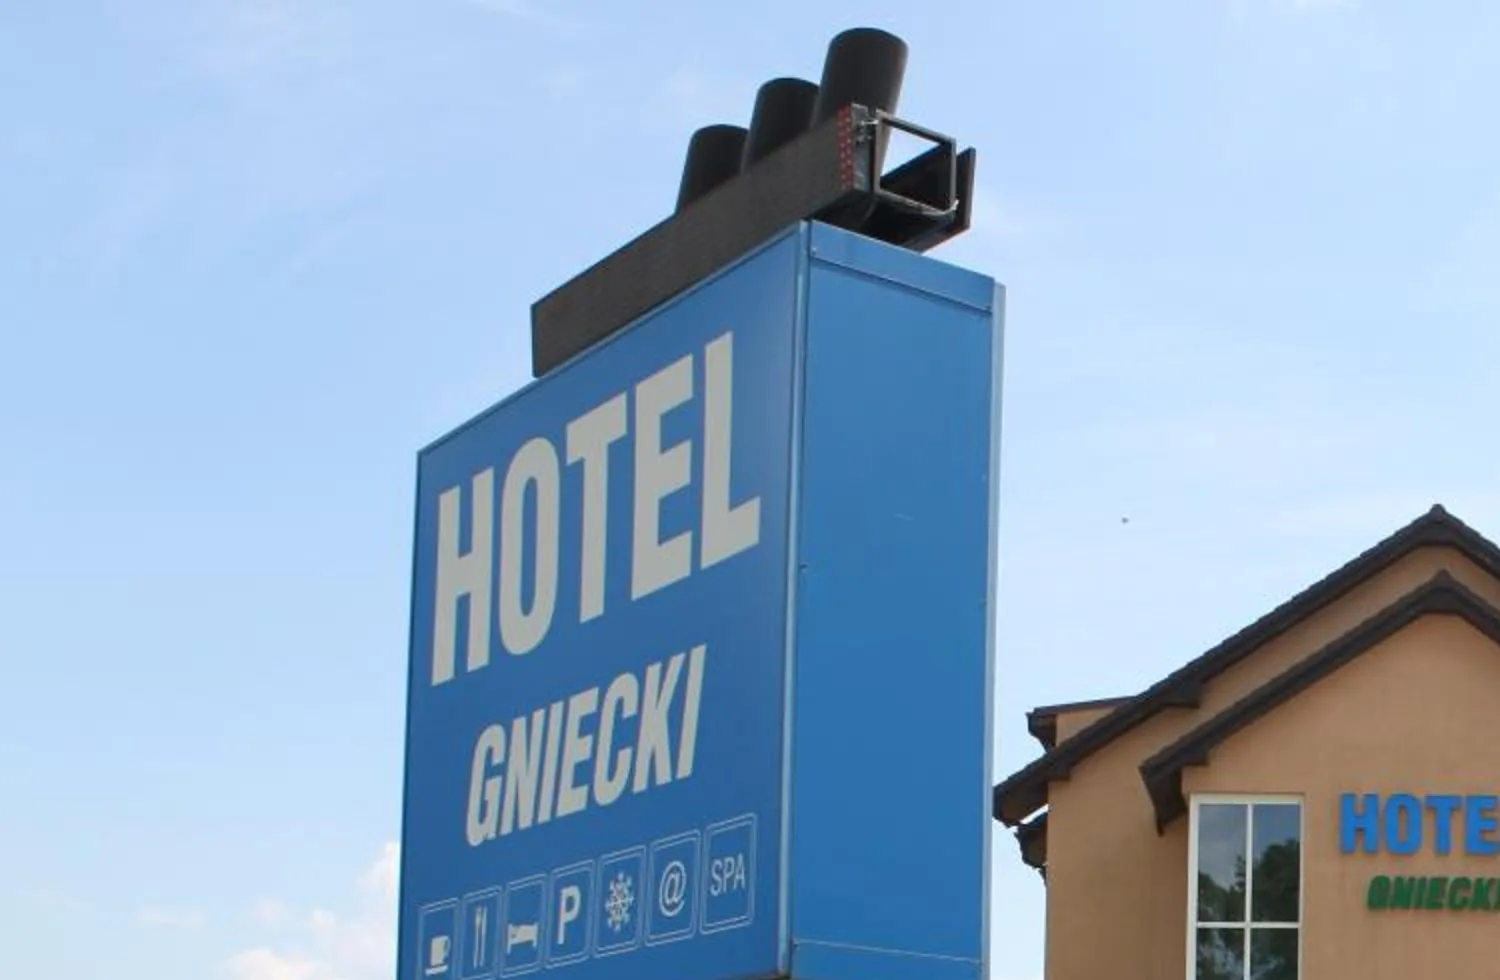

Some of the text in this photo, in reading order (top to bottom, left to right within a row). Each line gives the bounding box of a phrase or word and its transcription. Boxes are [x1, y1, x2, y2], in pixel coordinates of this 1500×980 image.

[430, 331, 762, 687] HOTEL
[465, 643, 708, 848] GNIECKI
[709, 852, 746, 897] SPA
